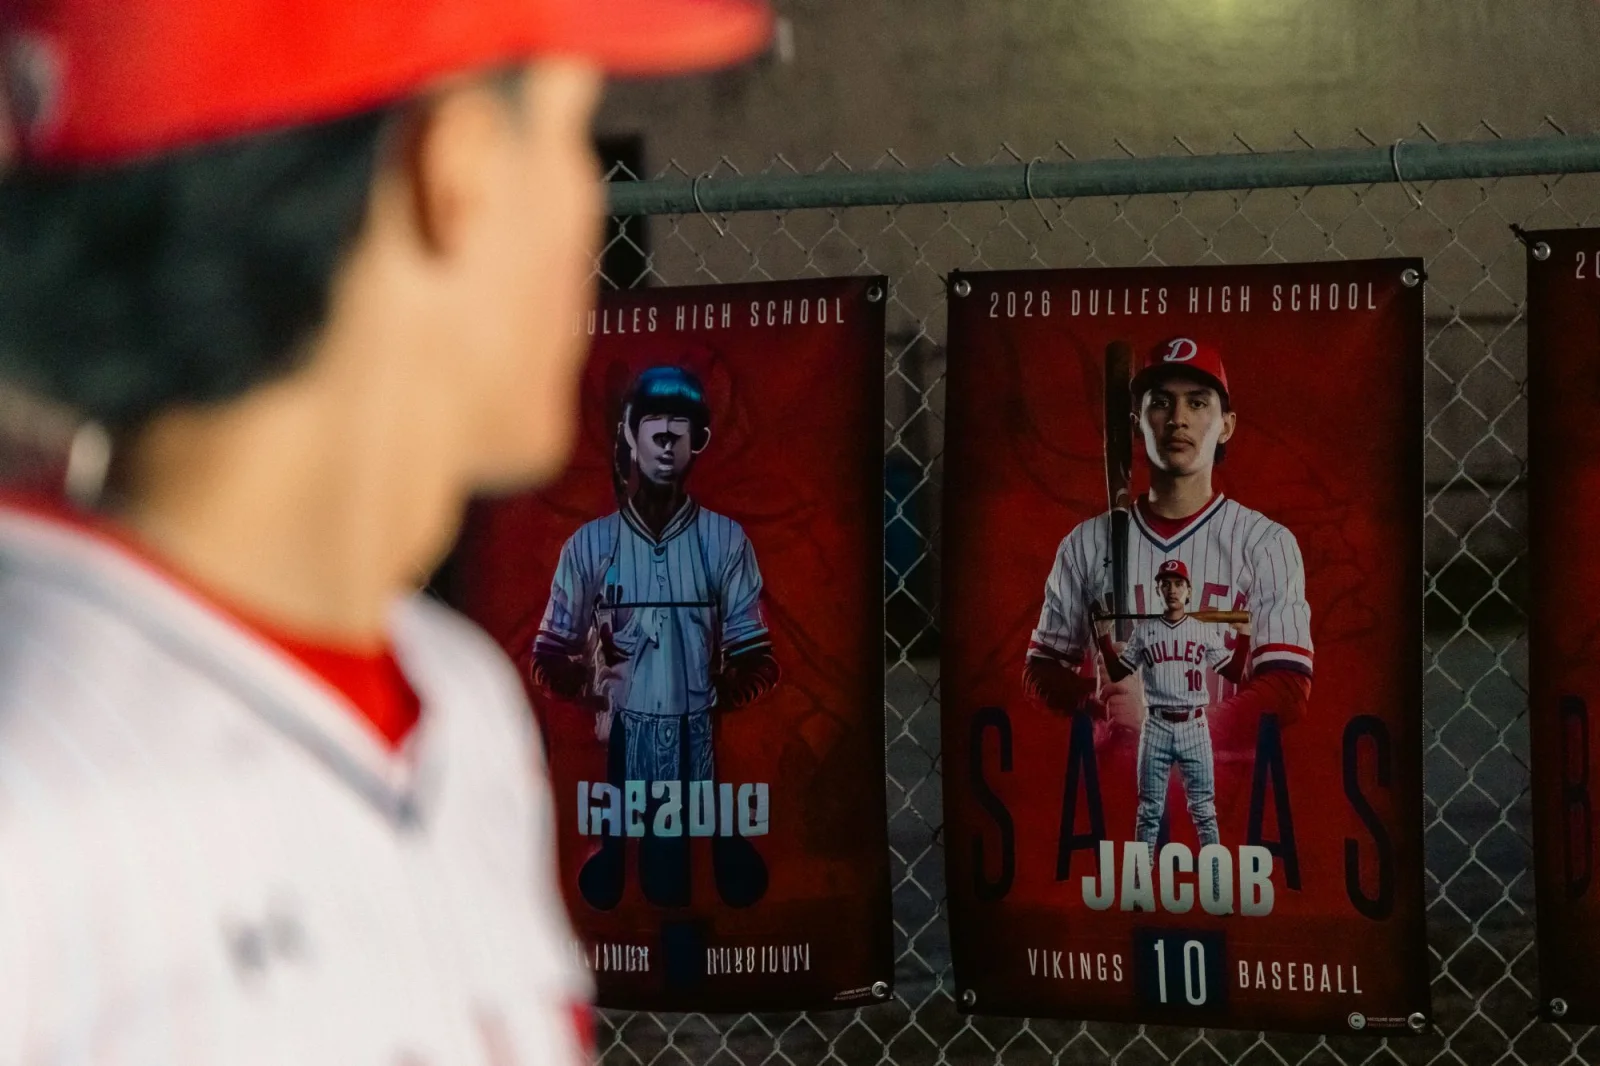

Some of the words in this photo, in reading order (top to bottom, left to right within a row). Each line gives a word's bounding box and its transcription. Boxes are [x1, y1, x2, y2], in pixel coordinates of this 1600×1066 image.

[675, 302, 732, 332] HIGH
[749, 297, 845, 327] SCHOOL
[989, 290, 1051, 318] 2026
[1071, 287, 1169, 316] DULLES
[1188, 285, 1251, 314] HIGH
[1272, 282, 1377, 312] SCHOOL
[1162, 337, 1198, 362] D
[1143, 639, 1207, 669] DULLES
[1184, 669, 1203, 692] 10
[969, 707, 1395, 921] SAAS
[1027, 947, 1124, 982] VIKINGS
[1153, 939, 1207, 1006] 10
[1238, 960, 1364, 995] BASEBALL
